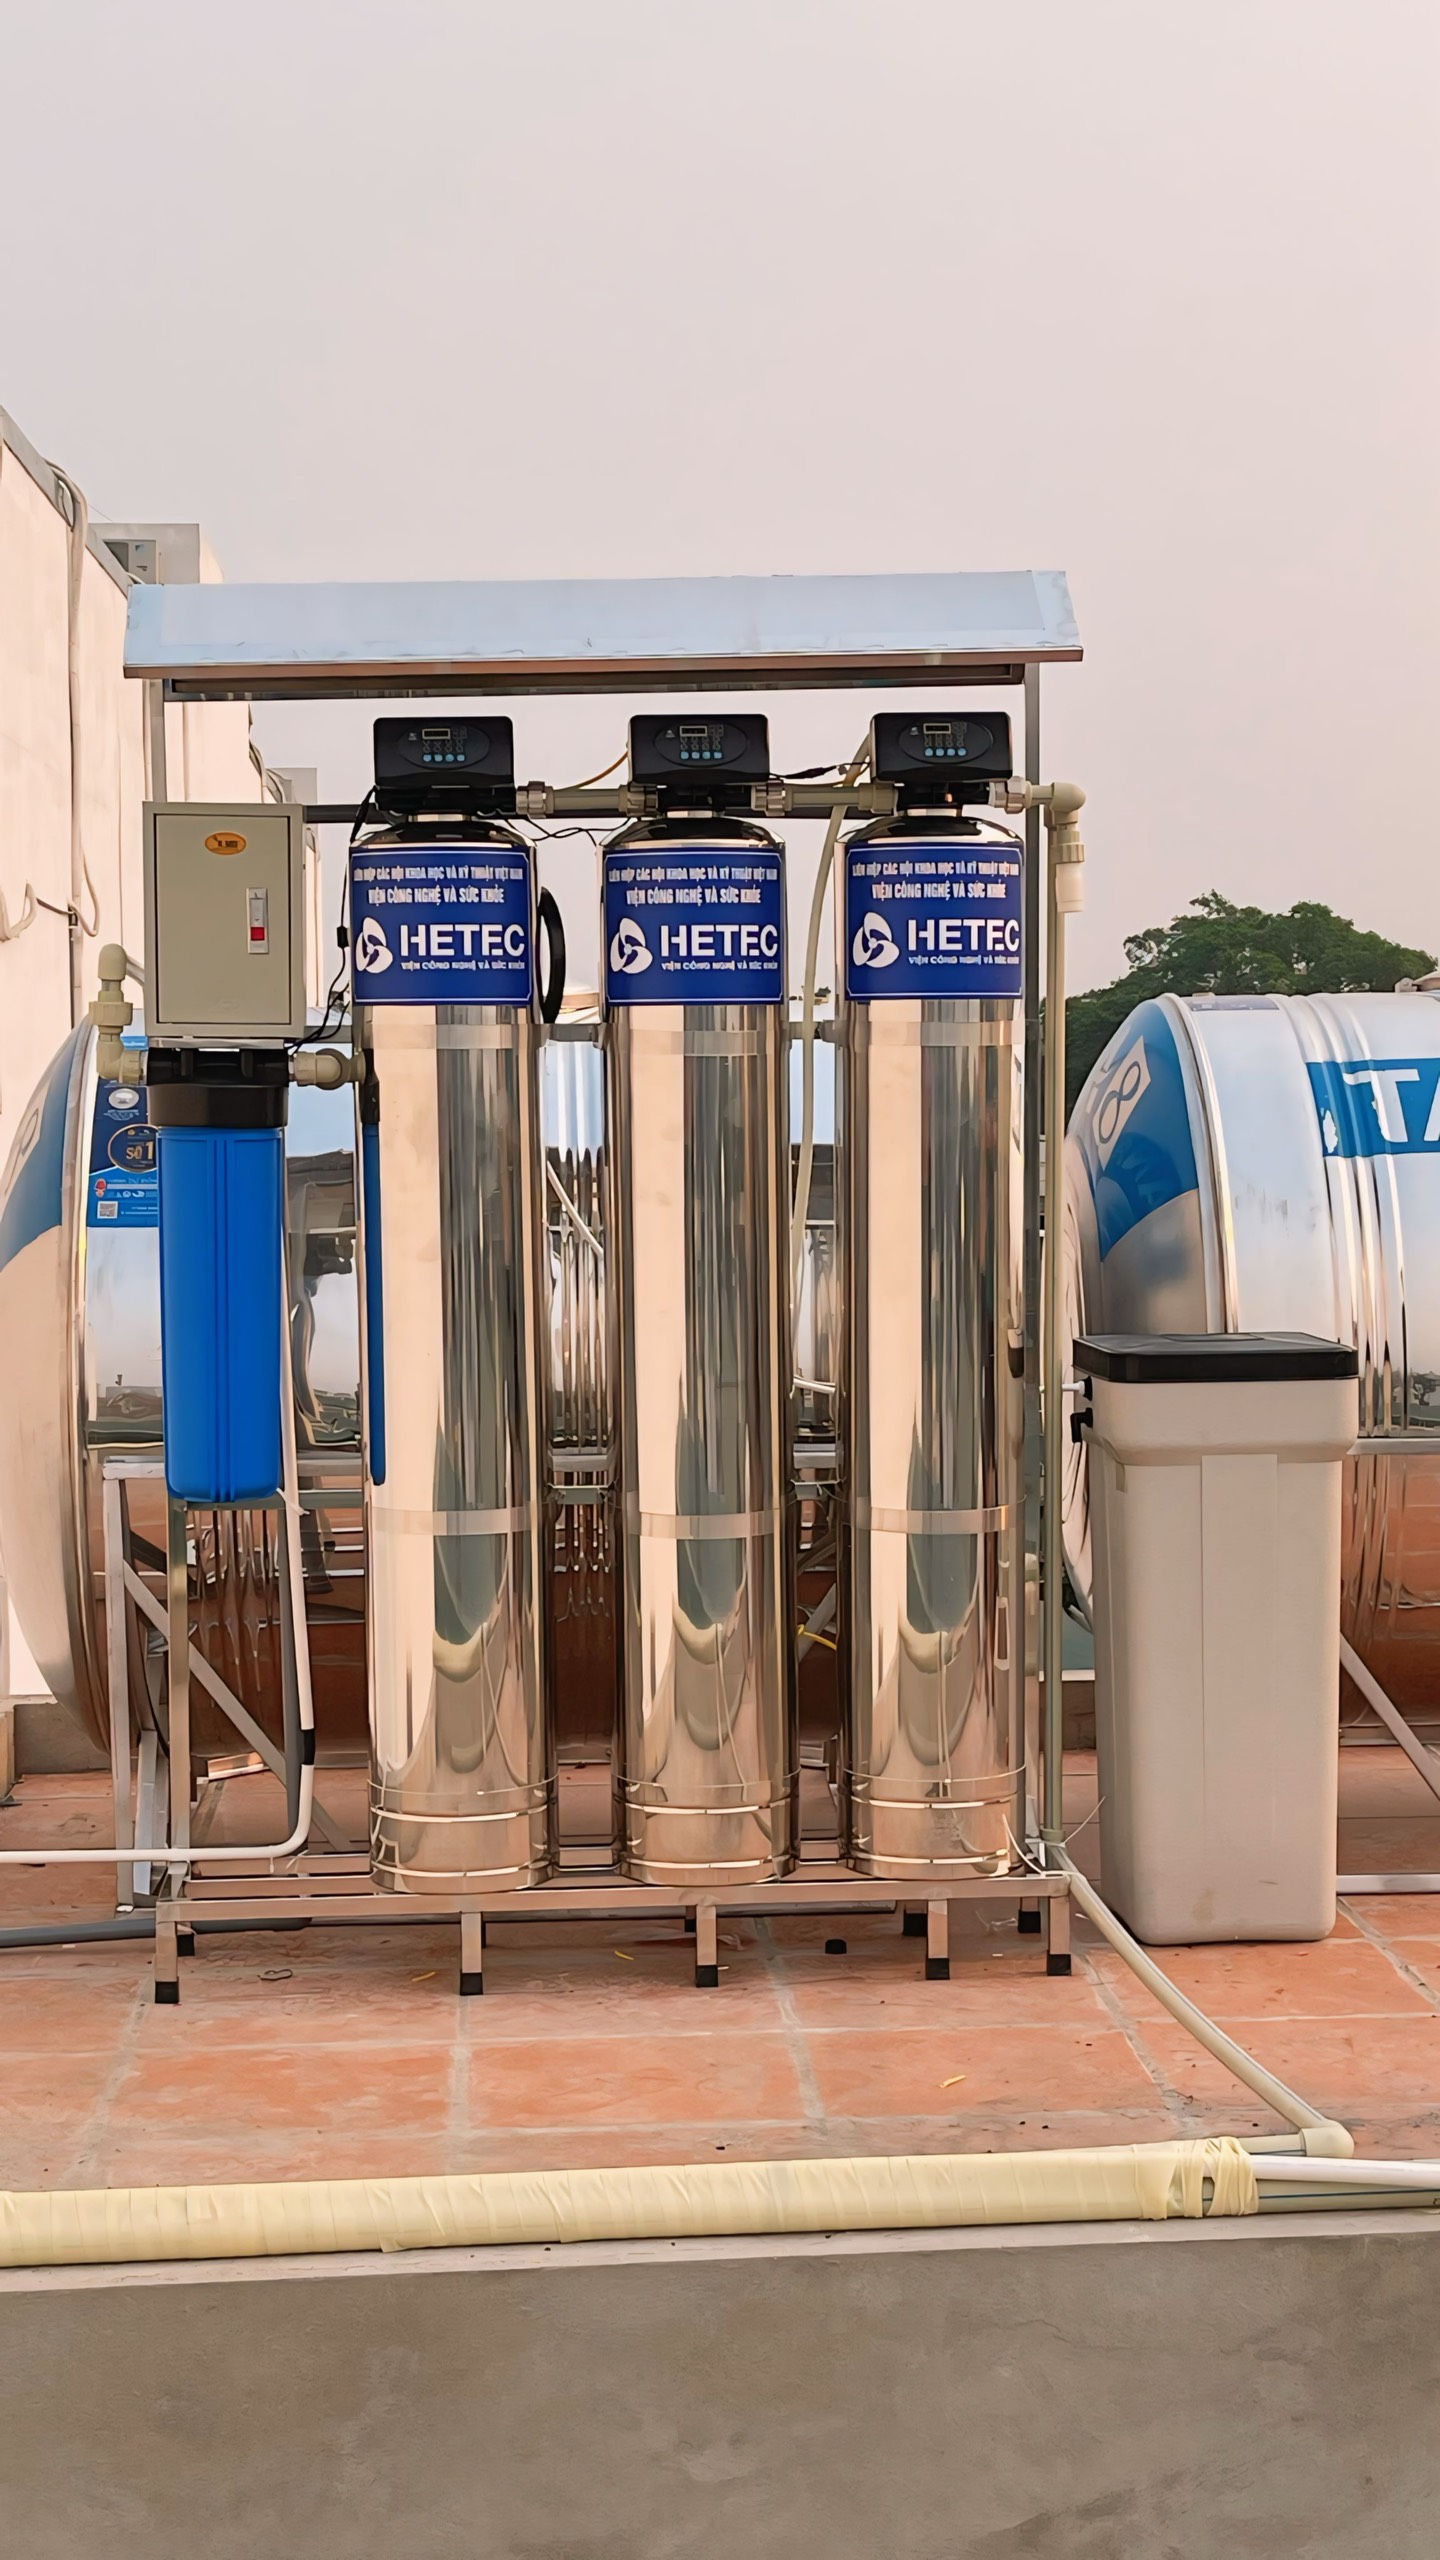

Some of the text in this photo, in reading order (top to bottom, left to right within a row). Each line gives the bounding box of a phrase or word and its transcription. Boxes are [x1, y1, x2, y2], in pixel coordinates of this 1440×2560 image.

[443, 884, 457, 902] VÀ
[704, 885, 718, 903] VÀ
[952, 880, 966, 898] VÀ
[400, 924, 525, 957] HETEC
[660, 924, 778, 957] HETEC
[908, 919, 1019, 952] HETEC
[1342, 1068, 1440, 1143] T
